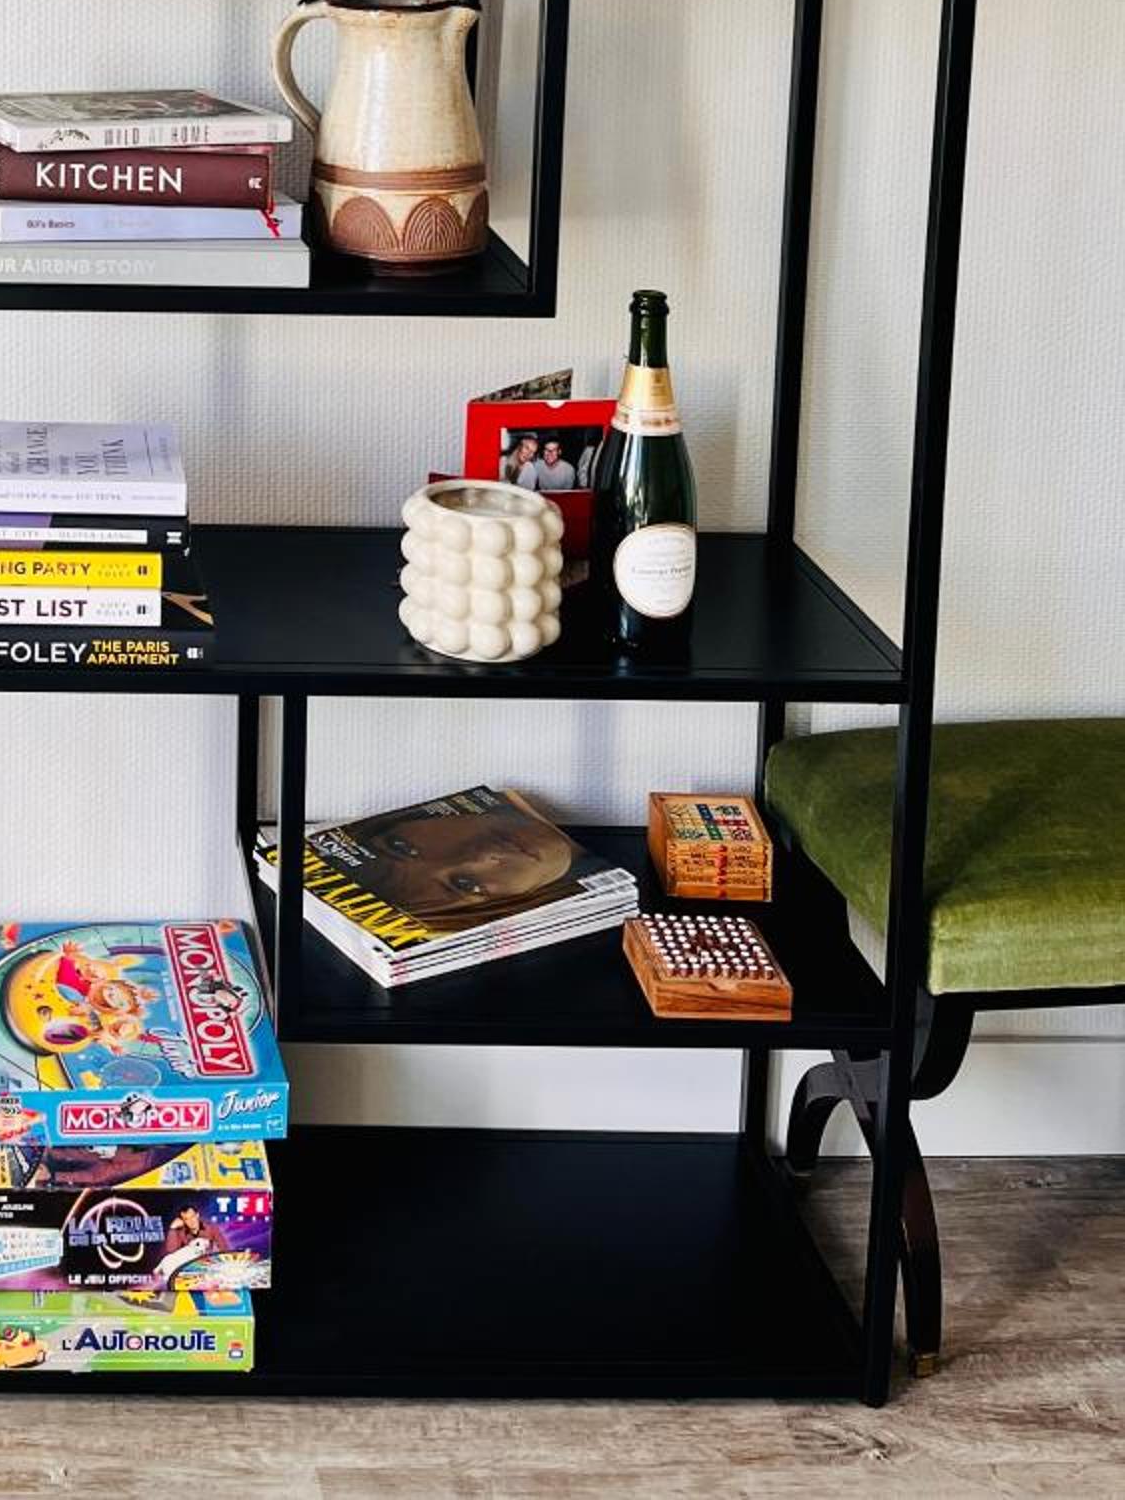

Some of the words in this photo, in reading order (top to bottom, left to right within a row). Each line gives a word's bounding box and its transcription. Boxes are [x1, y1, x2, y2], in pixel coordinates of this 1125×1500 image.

[35, 161, 184, 194] KITCHEN
[95, 259, 156, 276] STORY
[32, 561, 92, 576] PARTY
[36, 599, 88, 618] LIST
[92, 640, 122, 652] THE
[126, 640, 170, 653] PARIS
[86, 652, 180, 665] APARTMENT
[174, 928, 244, 1070] MONOPOLY
[217, 1088, 280, 1121] Junior
[68, 1274, 82, 1285] LE
[84, 1274, 106, 1285] JEU
